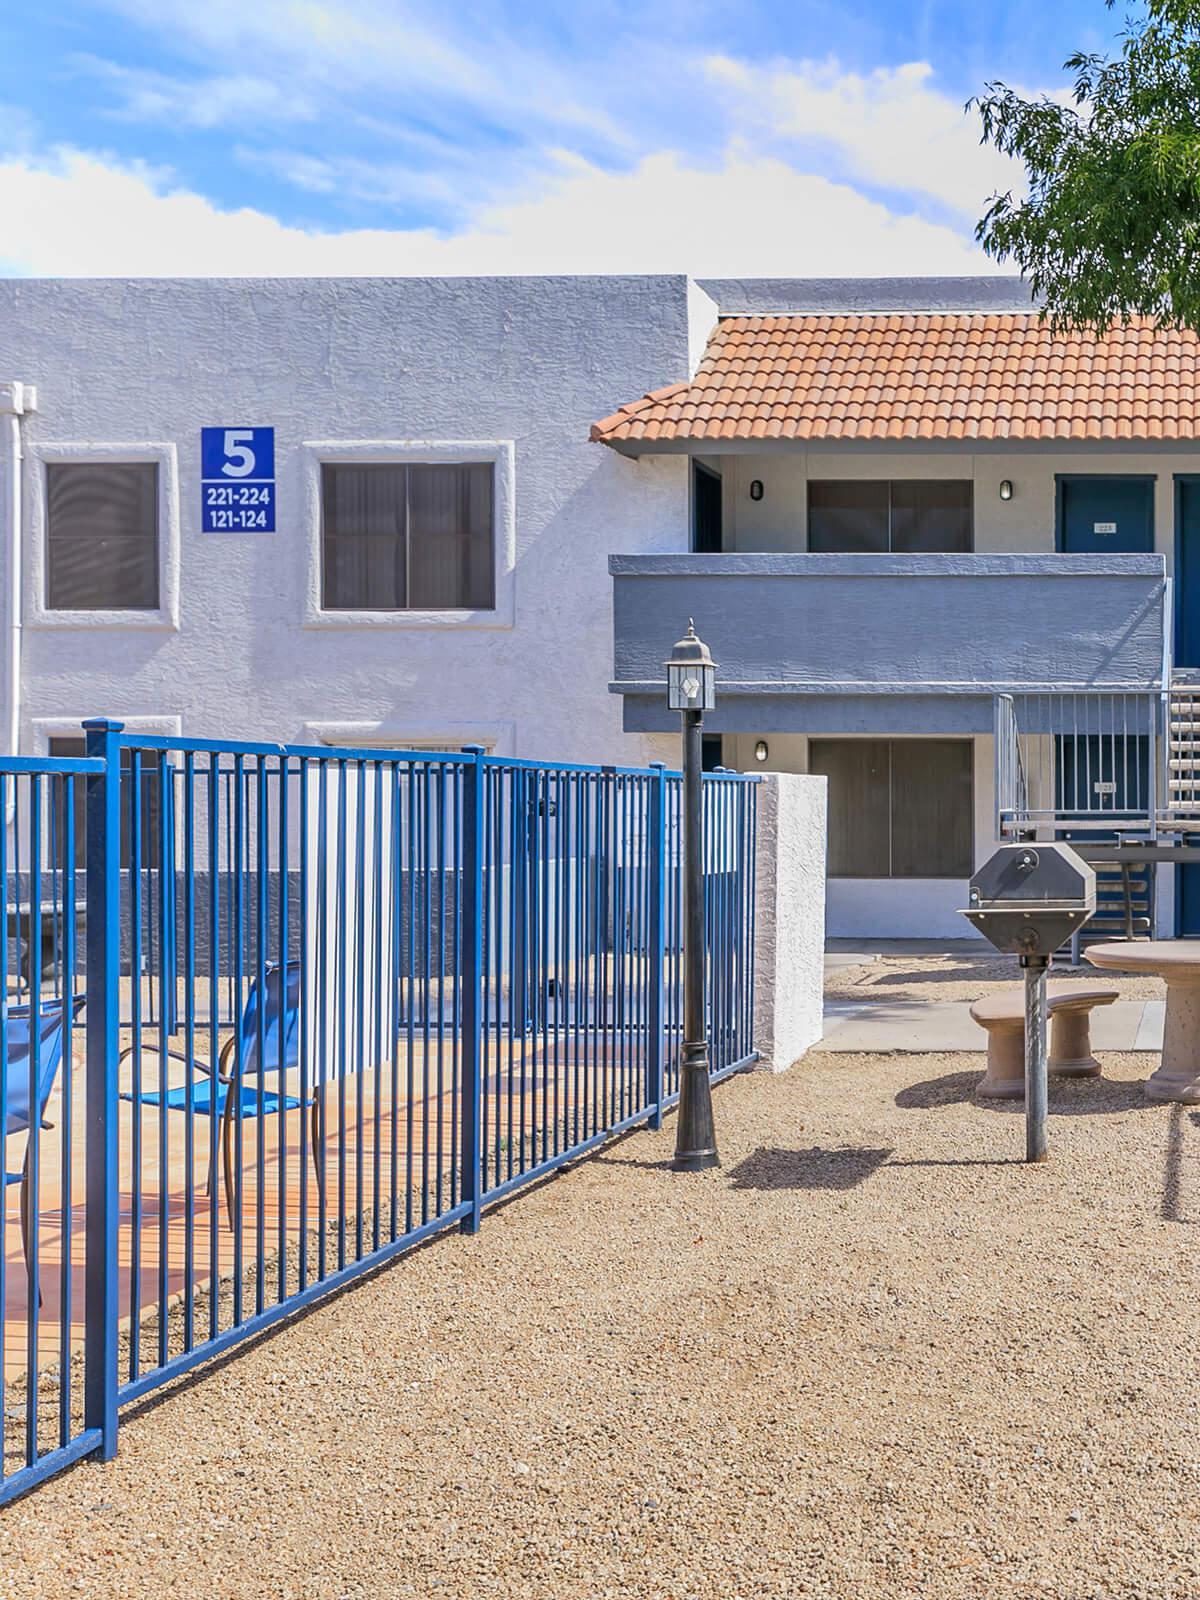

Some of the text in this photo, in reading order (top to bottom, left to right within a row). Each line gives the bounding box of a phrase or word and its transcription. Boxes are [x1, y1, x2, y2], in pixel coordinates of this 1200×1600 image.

[221, 430, 256, 478] 5
[207, 488, 270, 505] 221-224
[210, 510, 267, 528] 121-124
